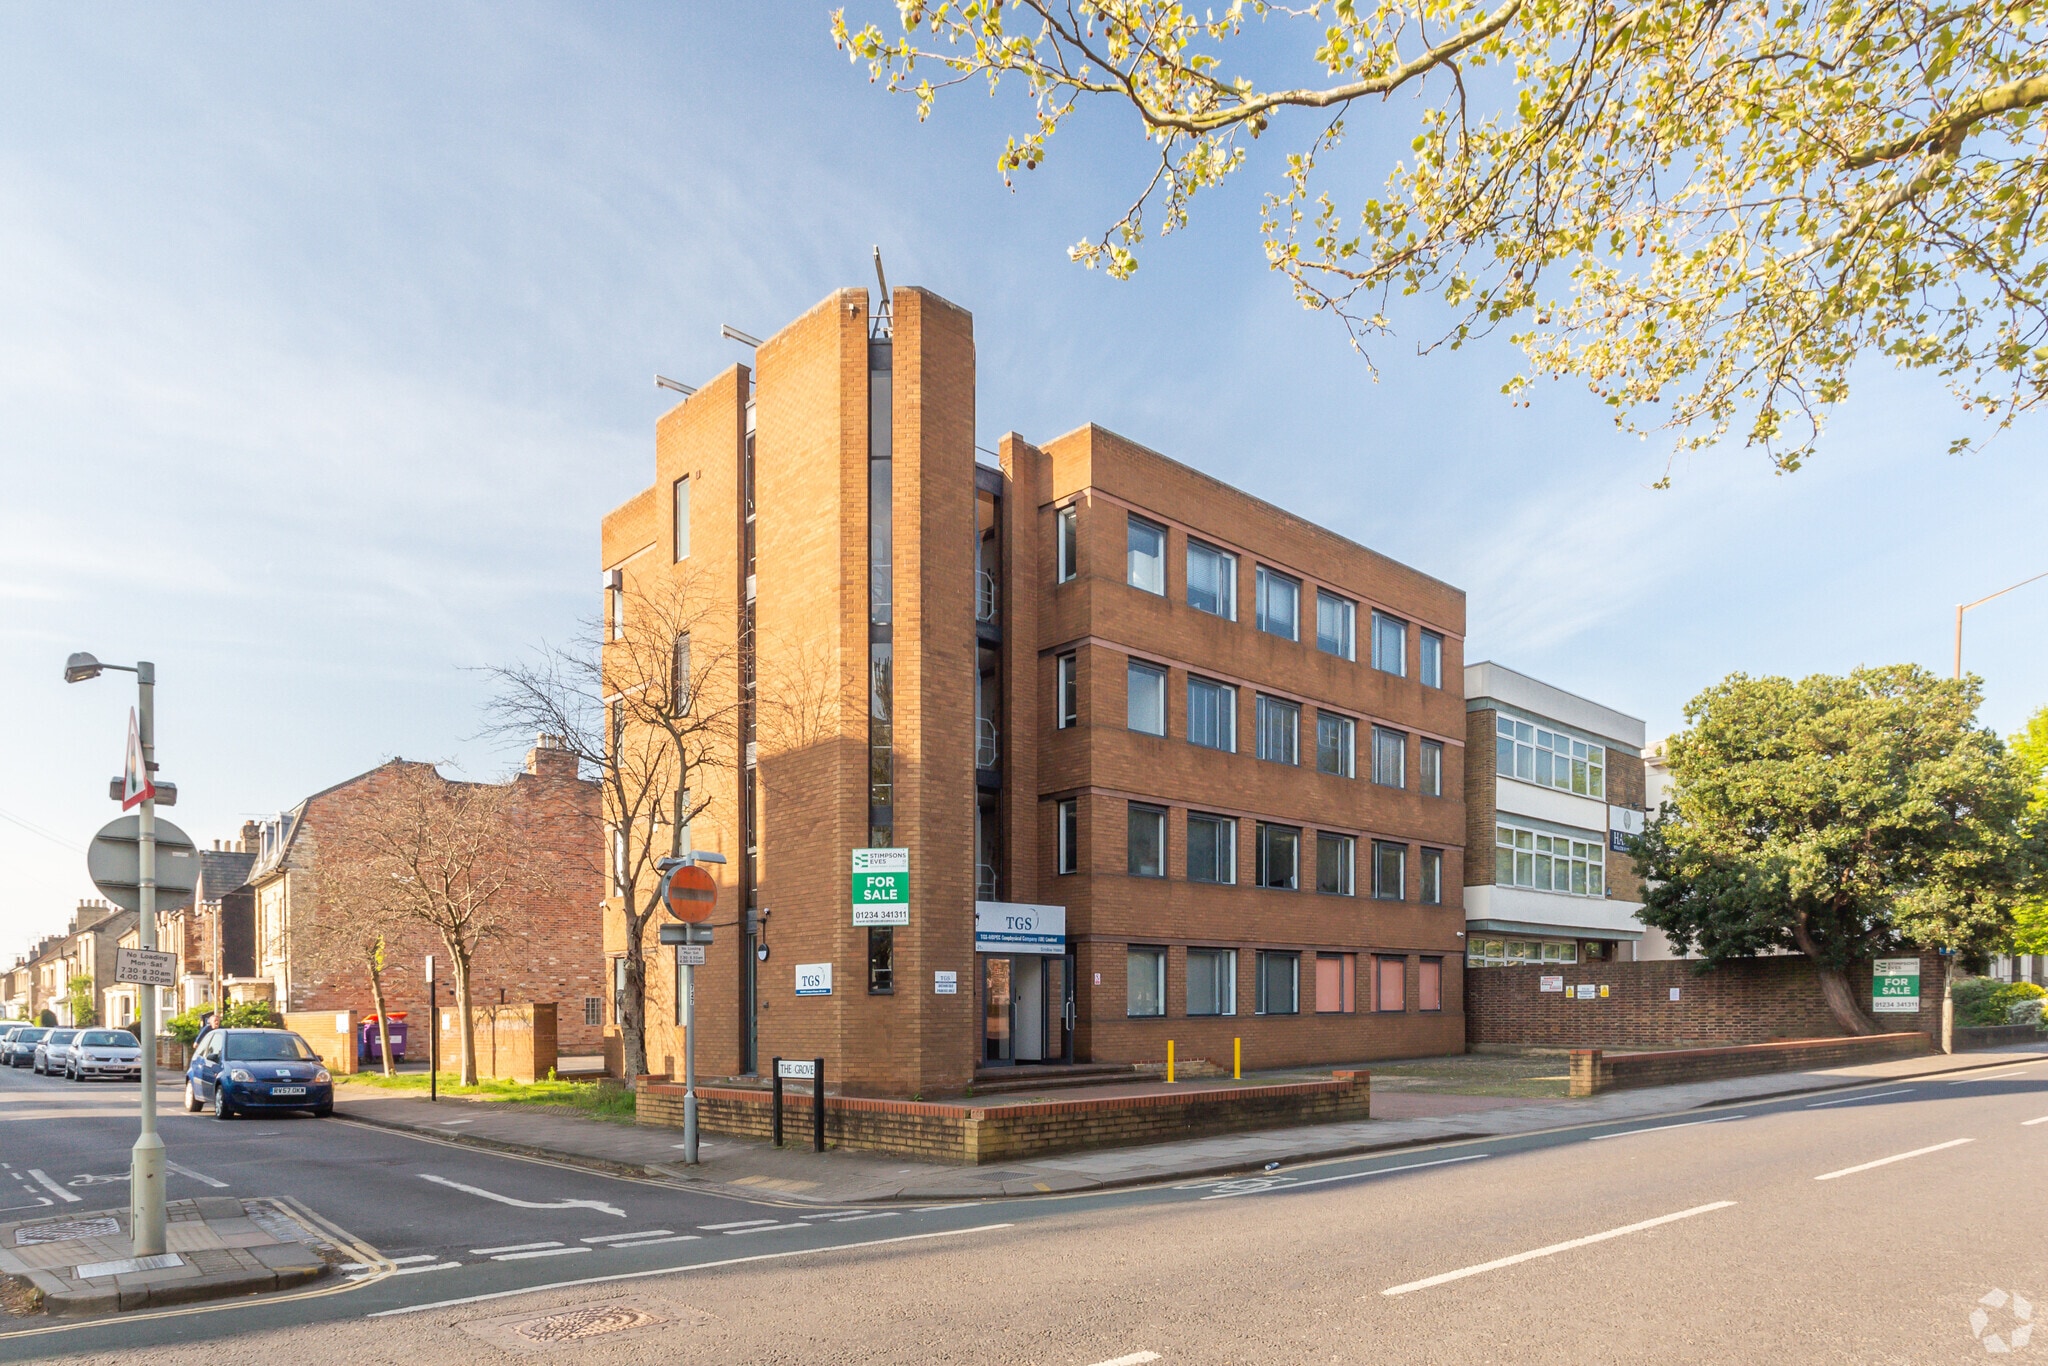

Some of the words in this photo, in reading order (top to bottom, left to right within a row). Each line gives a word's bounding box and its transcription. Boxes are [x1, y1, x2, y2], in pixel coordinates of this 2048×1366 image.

[867, 877, 895, 887] FOR
[864, 889, 898, 900] SALE
[856, 911, 878, 919] 01234
[1006, 917, 1032, 930] TGS
[140, 953, 168, 961] Loading
[802, 975, 820, 986] TGS
[1885, 978, 1908, 986] FOR
[1882, 987, 1911, 995] SALE
[780, 1064, 791, 1073] THE
[794, 1065, 814, 1074] GROVE
